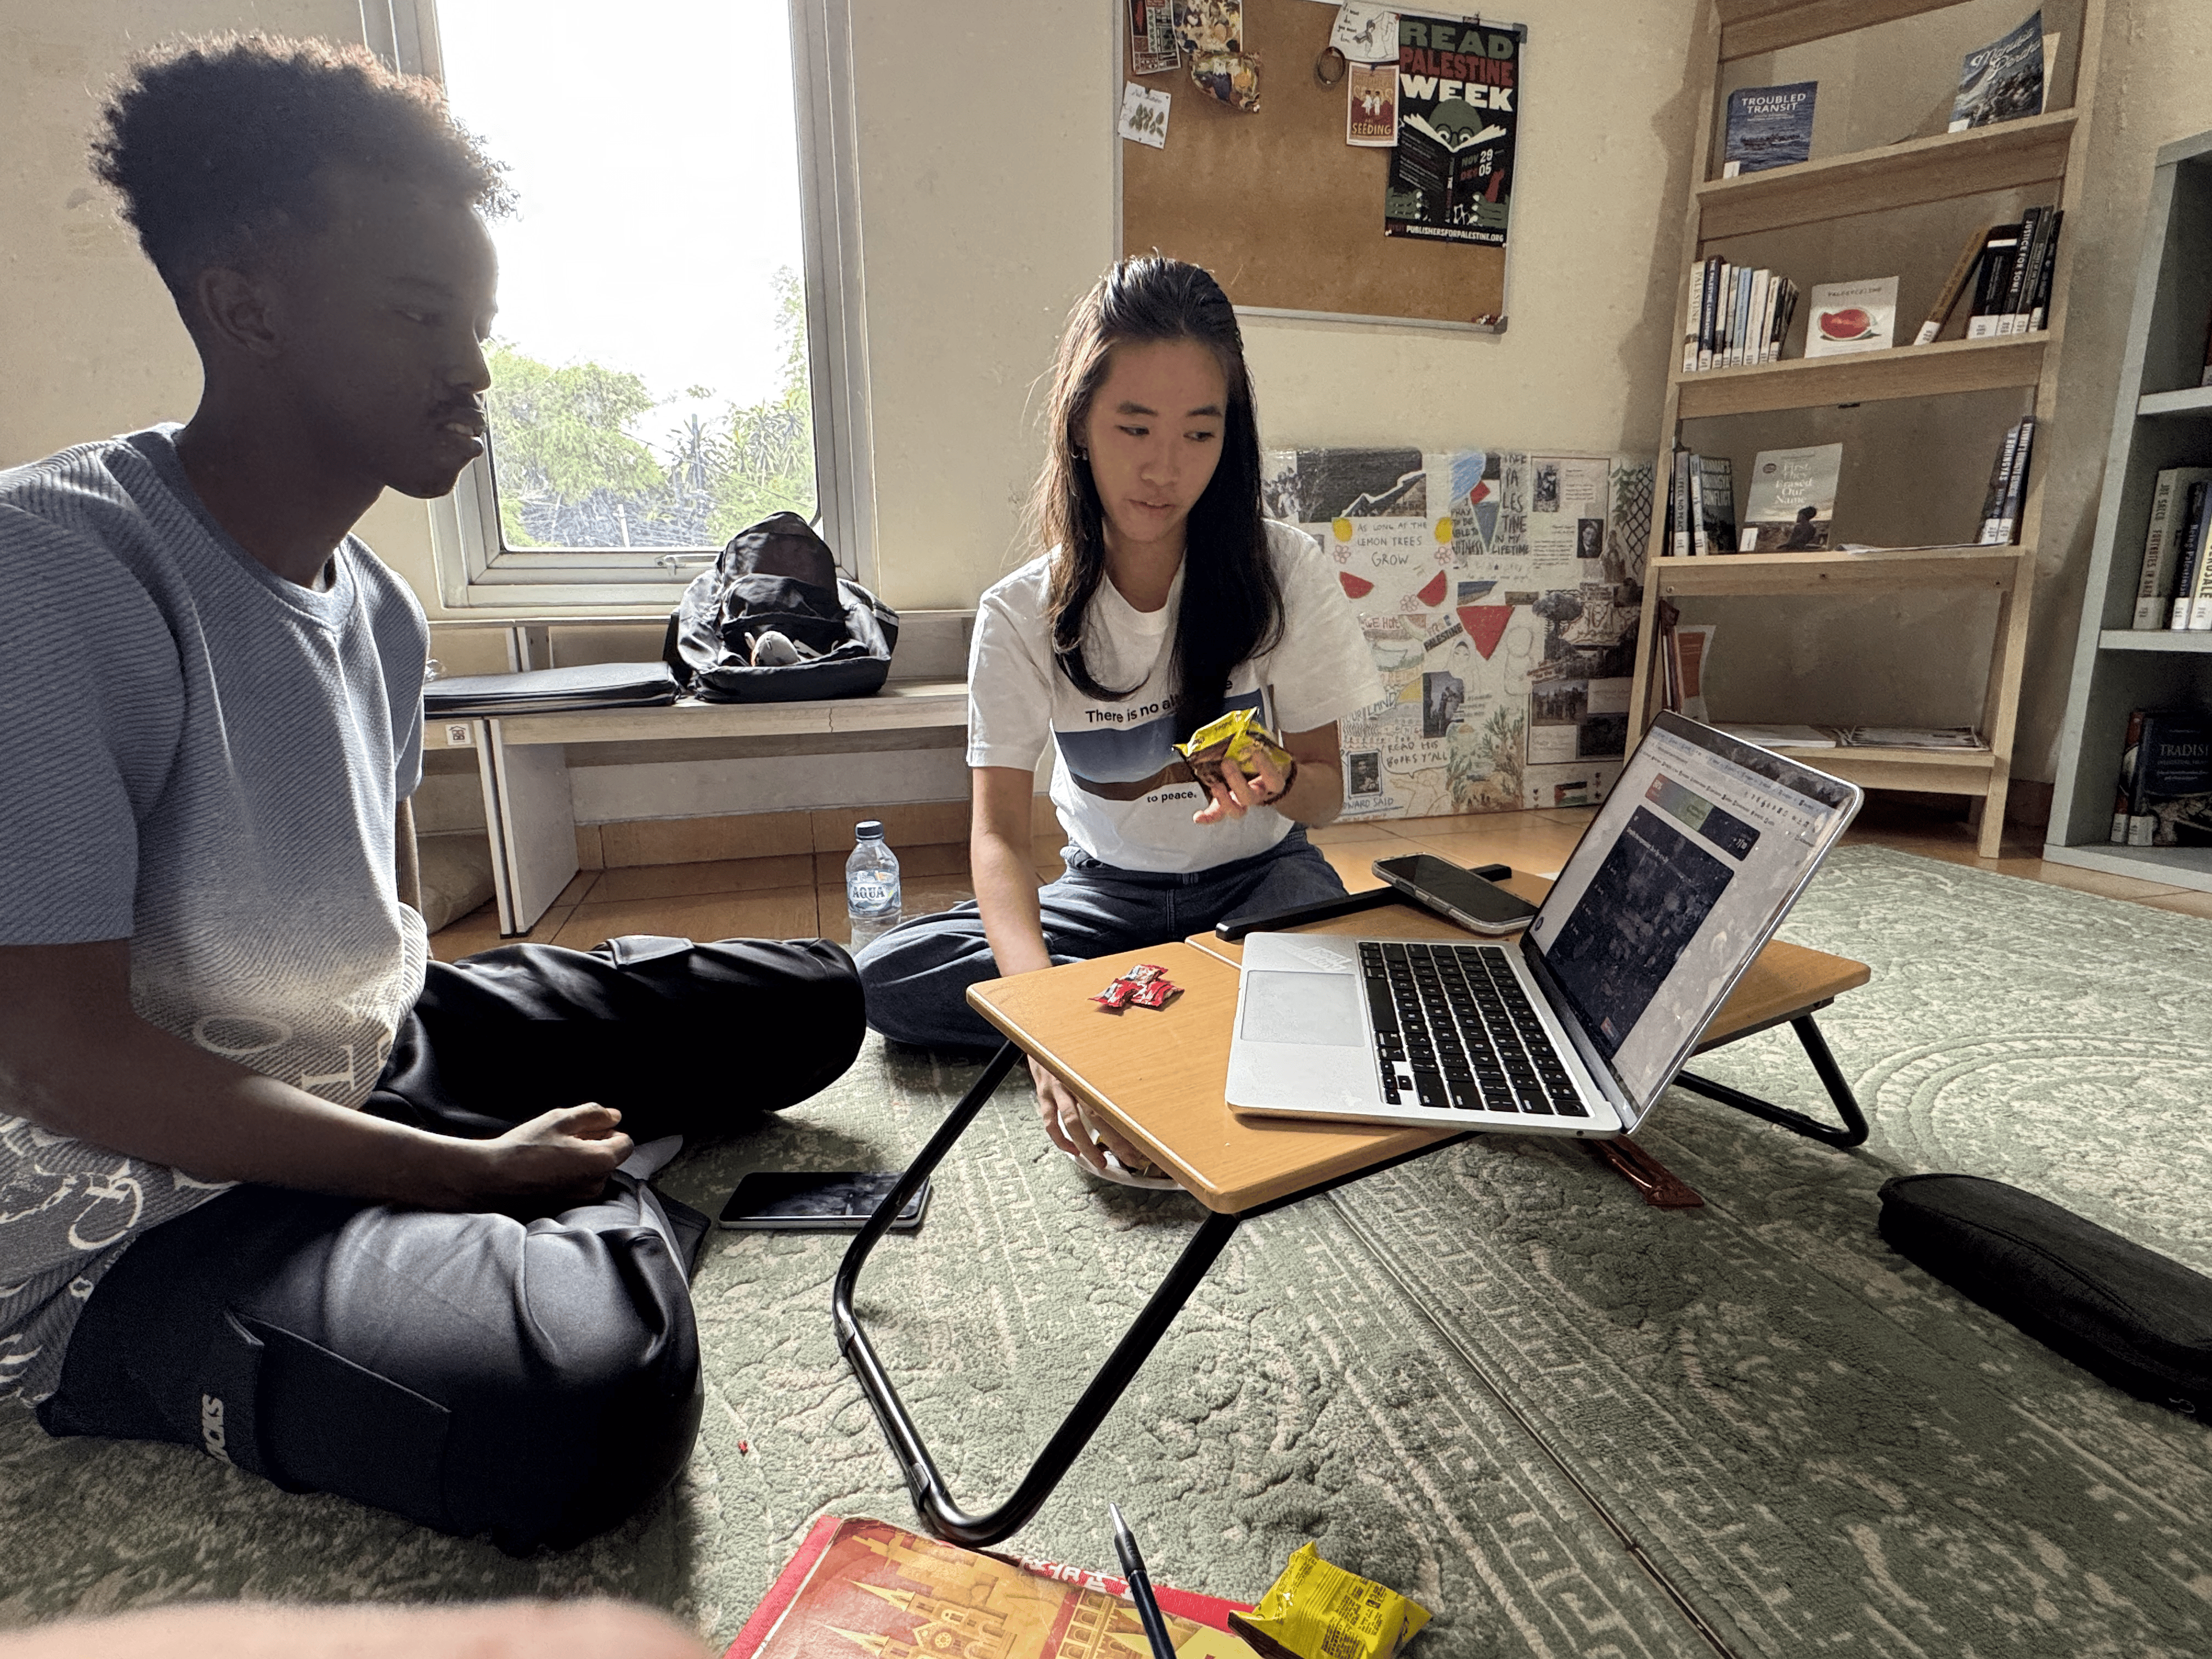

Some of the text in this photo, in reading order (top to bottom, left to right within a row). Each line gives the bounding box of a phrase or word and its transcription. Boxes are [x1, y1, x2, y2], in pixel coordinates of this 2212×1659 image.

[1400, 20, 1514, 60] READ
[1400, 46, 1513, 86] PALESTINE
[1400, 74, 1513, 112] WEEK
[1741, 93, 1806, 106] TROUBLED
[1747, 102, 1798, 114] TRANSIT
[1352, 122, 1392, 135] SEEDING
[1462, 149, 1493, 167] NOV 29
[1479, 162, 1492, 177] 05
[1406, 225, 1504, 242] PUBLISHERSFORPALESTINE.ORG
[2010, 221, 2033, 293] JUSTICE FOR SOME
[1784, 462, 1809, 472] First
[1999, 439, 2015, 481] ROHINGYAS
[1506, 468, 1519, 487] PA
[1776, 477, 1813, 488] Erased
[2159, 483, 2170, 495] JOE
[1503, 492, 1523, 512] LES
[1678, 500, 1684, 511] NO
[1775, 495, 1807, 504] Name
[2155, 499, 2168, 521] SACCO
[1357, 523, 1367, 532] AS
[1501, 515, 1527, 533] TINE
[1357, 535, 1422, 546] LEMON TREES
[1509, 535, 1520, 543] MY
[2185, 524, 2198, 548] Being
[1492, 544, 1530, 555] LIFETIME
[1372, 551, 1409, 567] GROW
[1424, 623, 1463, 652] PALESTINE
[1085, 703, 1159, 723] There is no
[1387, 741, 1438, 753] READ HIS
[1386, 754, 1417, 768] BOOKS
[1161, 791, 1197, 803] peace.
[1344, 797, 1394, 810] DWARD SAID
[853, 887, 885, 900] AQUA
